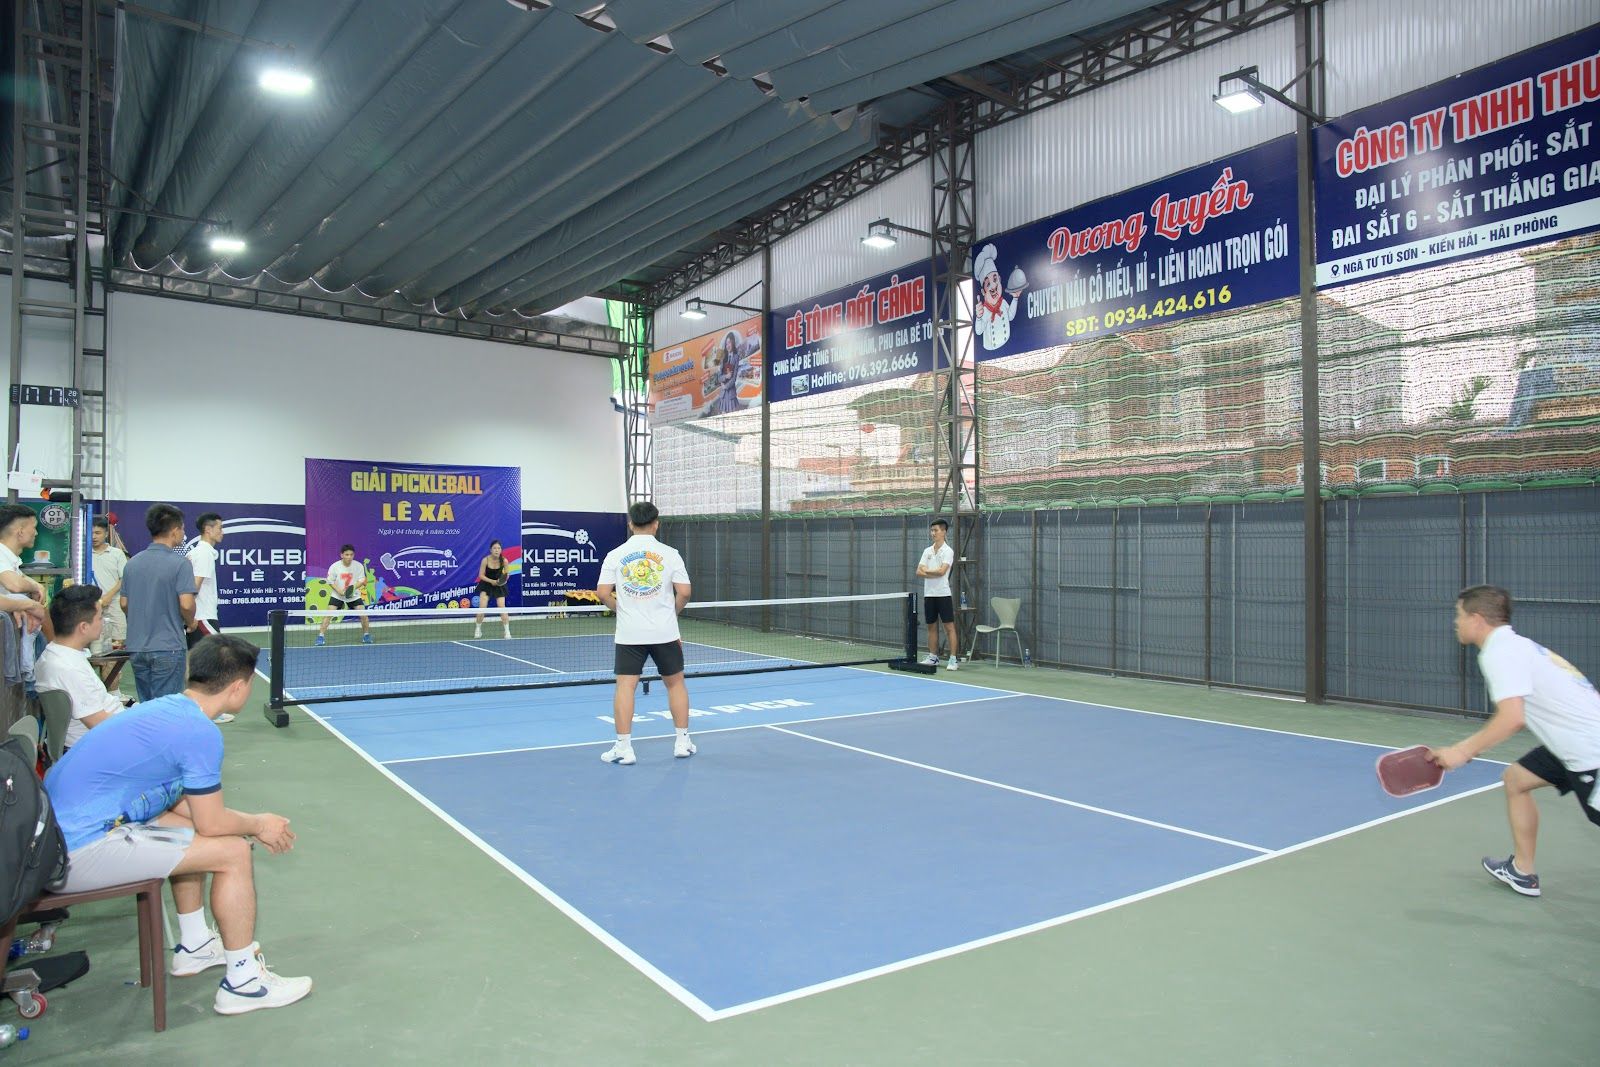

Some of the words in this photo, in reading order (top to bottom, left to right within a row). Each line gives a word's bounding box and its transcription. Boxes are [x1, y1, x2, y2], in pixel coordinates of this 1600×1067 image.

[1336, 126, 1407, 178] CÔNG
[1411, 107, 1446, 155] TY
[1449, 77, 1533, 143] TNHH
[1355, 184, 1386, 210] ĐẠI
[1391, 174, 1411, 200] LÝ
[1418, 157, 1473, 192] PHÂN
[1480, 134, 1539, 175] PHỐI:
[1546, 118, 1593, 156] SẮT
[1047, 211, 1148, 265] Dương
[1151, 167, 1254, 241] Luyền
[1331, 226, 1361, 249] ĐAI
[1366, 209, 1400, 240] SẮT
[1405, 209, 1417, 231] 6
[1437, 190, 1476, 224] SẮT
[1481, 172, 1556, 212] THẲNG
[1343, 258, 1363, 275] NGÃ
[1366, 253, 1381, 269] TƯ
[1381, 249, 1395, 265] TÚ
[1396, 247, 1418, 264] SƠN
[1429, 237, 1455, 255] KIẾN
[1458, 230, 1478, 250] HẢI
[1489, 223, 1510, 241] HẢI
[1514, 215, 1559, 237] PHÒNG
[1027, 281, 1064, 319] CHUYÊN
[1066, 267, 1087, 310] NẤU
[1105, 258, 1133, 300] HIẾU,
[1136, 250, 1149, 293] HỈ
[1158, 246, 1185, 287] LIÊN
[1188, 241, 1223, 280] HOAN
[1225, 230, 1261, 275] TRỌN
[1264, 218, 1288, 262] GÓI
[785, 309, 804, 350] BÊ
[805, 302, 843, 344] TÔNG
[877, 274, 926, 325] CẢNG
[1066, 315, 1099, 336] SĐT:
[1104, 284, 1232, 328] 0934.424.616
[773, 360, 790, 376] CUNG
[789, 349, 802, 371] CẤP
[802, 351, 812, 370] BÊ
[812, 347, 829, 366] TÔNG
[878, 332, 894, 353] PHỤ
[896, 328, 909, 348] GIA
[910, 321, 920, 343] BÊ
[811, 369, 846, 388] Hotline:
[848, 352, 919, 381] 076.392.6666
[26, 386, 39, 402] 17
[49, 388, 63, 404] 17
[351, 466, 386, 492] GIẢI
[391, 472, 483, 495] PICKLEBALL
[382, 500, 412, 522] LÊ
[419, 501, 455, 522] XÁ
[378, 528, 396, 536] Ngày
[405, 528, 424, 536] tháng
[397, 560, 459, 568] PICKLEBALL
[522, 549, 599, 563] KLEBALL
[554, 565, 579, 577] XÁ
[232, 568, 265, 582] LÊ
[440, 586, 469, 601] nghiệm
